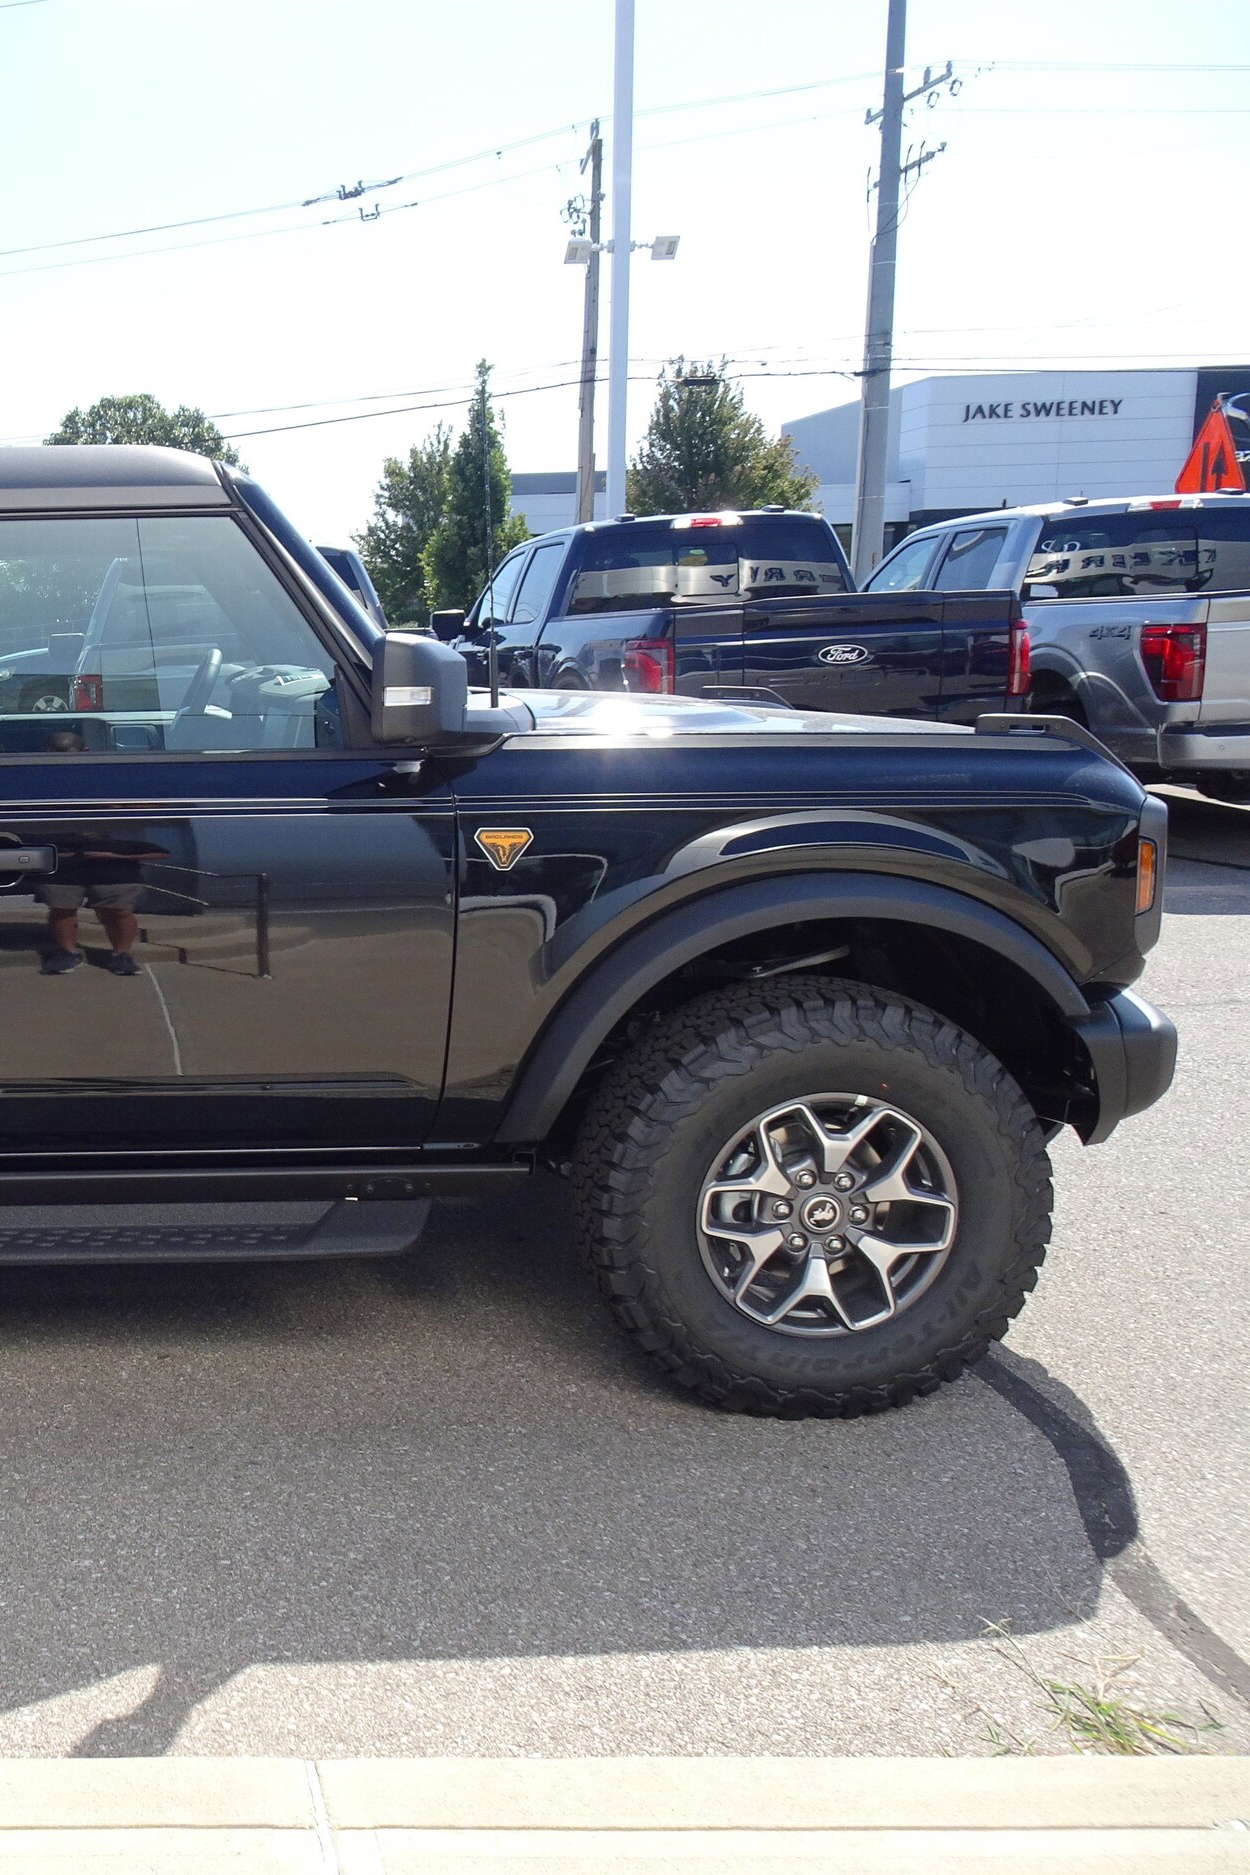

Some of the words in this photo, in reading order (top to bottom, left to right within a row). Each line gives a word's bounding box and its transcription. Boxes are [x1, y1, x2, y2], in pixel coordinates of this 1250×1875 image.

[962, 402, 1014, 423] JAKE
[1019, 399, 1123, 418] SWEENEY
[825, 646, 861, 662] Ford
